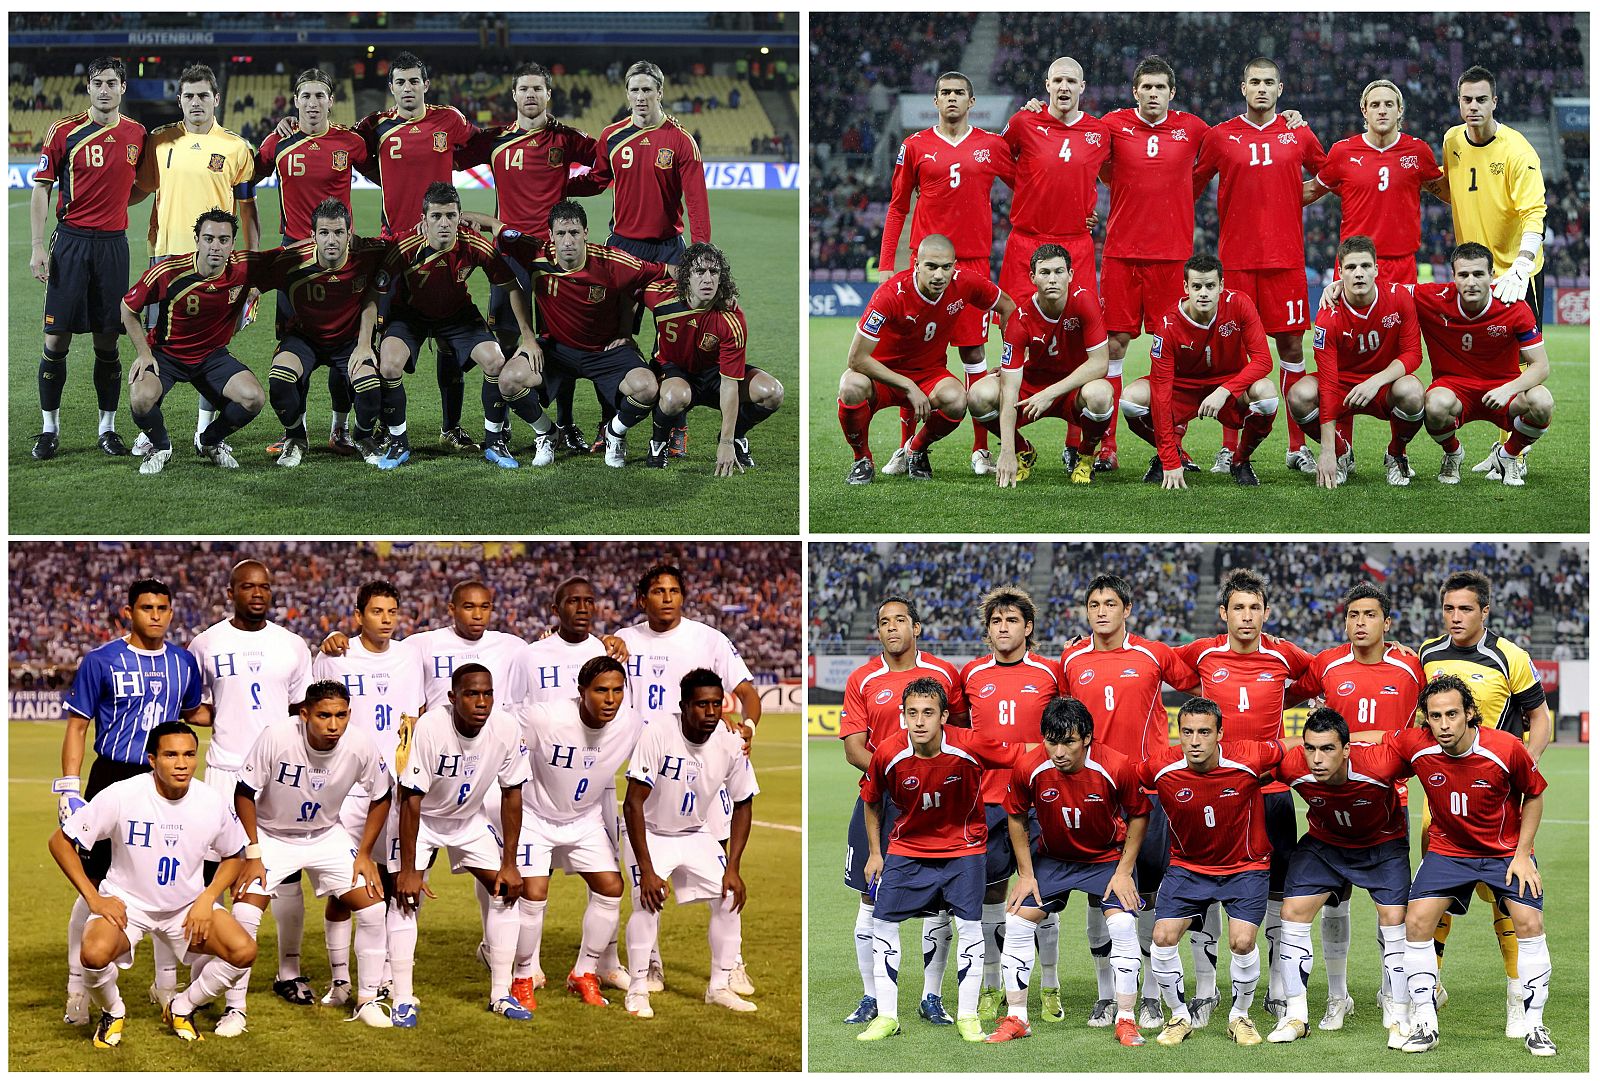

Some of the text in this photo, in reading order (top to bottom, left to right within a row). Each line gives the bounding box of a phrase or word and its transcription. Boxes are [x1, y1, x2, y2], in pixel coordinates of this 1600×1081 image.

[128, 32, 214, 45] RUSTENBURG
[85, 144, 104, 167] 18
[389, 136, 402, 159] 2
[621, 146, 634, 169] 9
[1058, 139, 1072, 162] 4
[1146, 135, 1159, 157] 6
[1249, 143, 1273, 166] 11
[166, 148, 173, 169] 1
[287, 153, 305, 176] 15
[505, 148, 523, 171] 14
[950, 163, 961, 188] 5
[1378, 166, 1390, 191] 3
[1468, 167, 1478, 191] 1
[418, 270, 430, 288] 7
[548, 276, 558, 298] 11
[307, 283, 326, 302] 10
[186, 294, 200, 315] 8
[1286, 299, 1304, 325] 11
[665, 321, 679, 343] 5
[924, 322, 937, 342] 8
[1357, 330, 1379, 354] 10
[1461, 333, 1473, 351] 9
